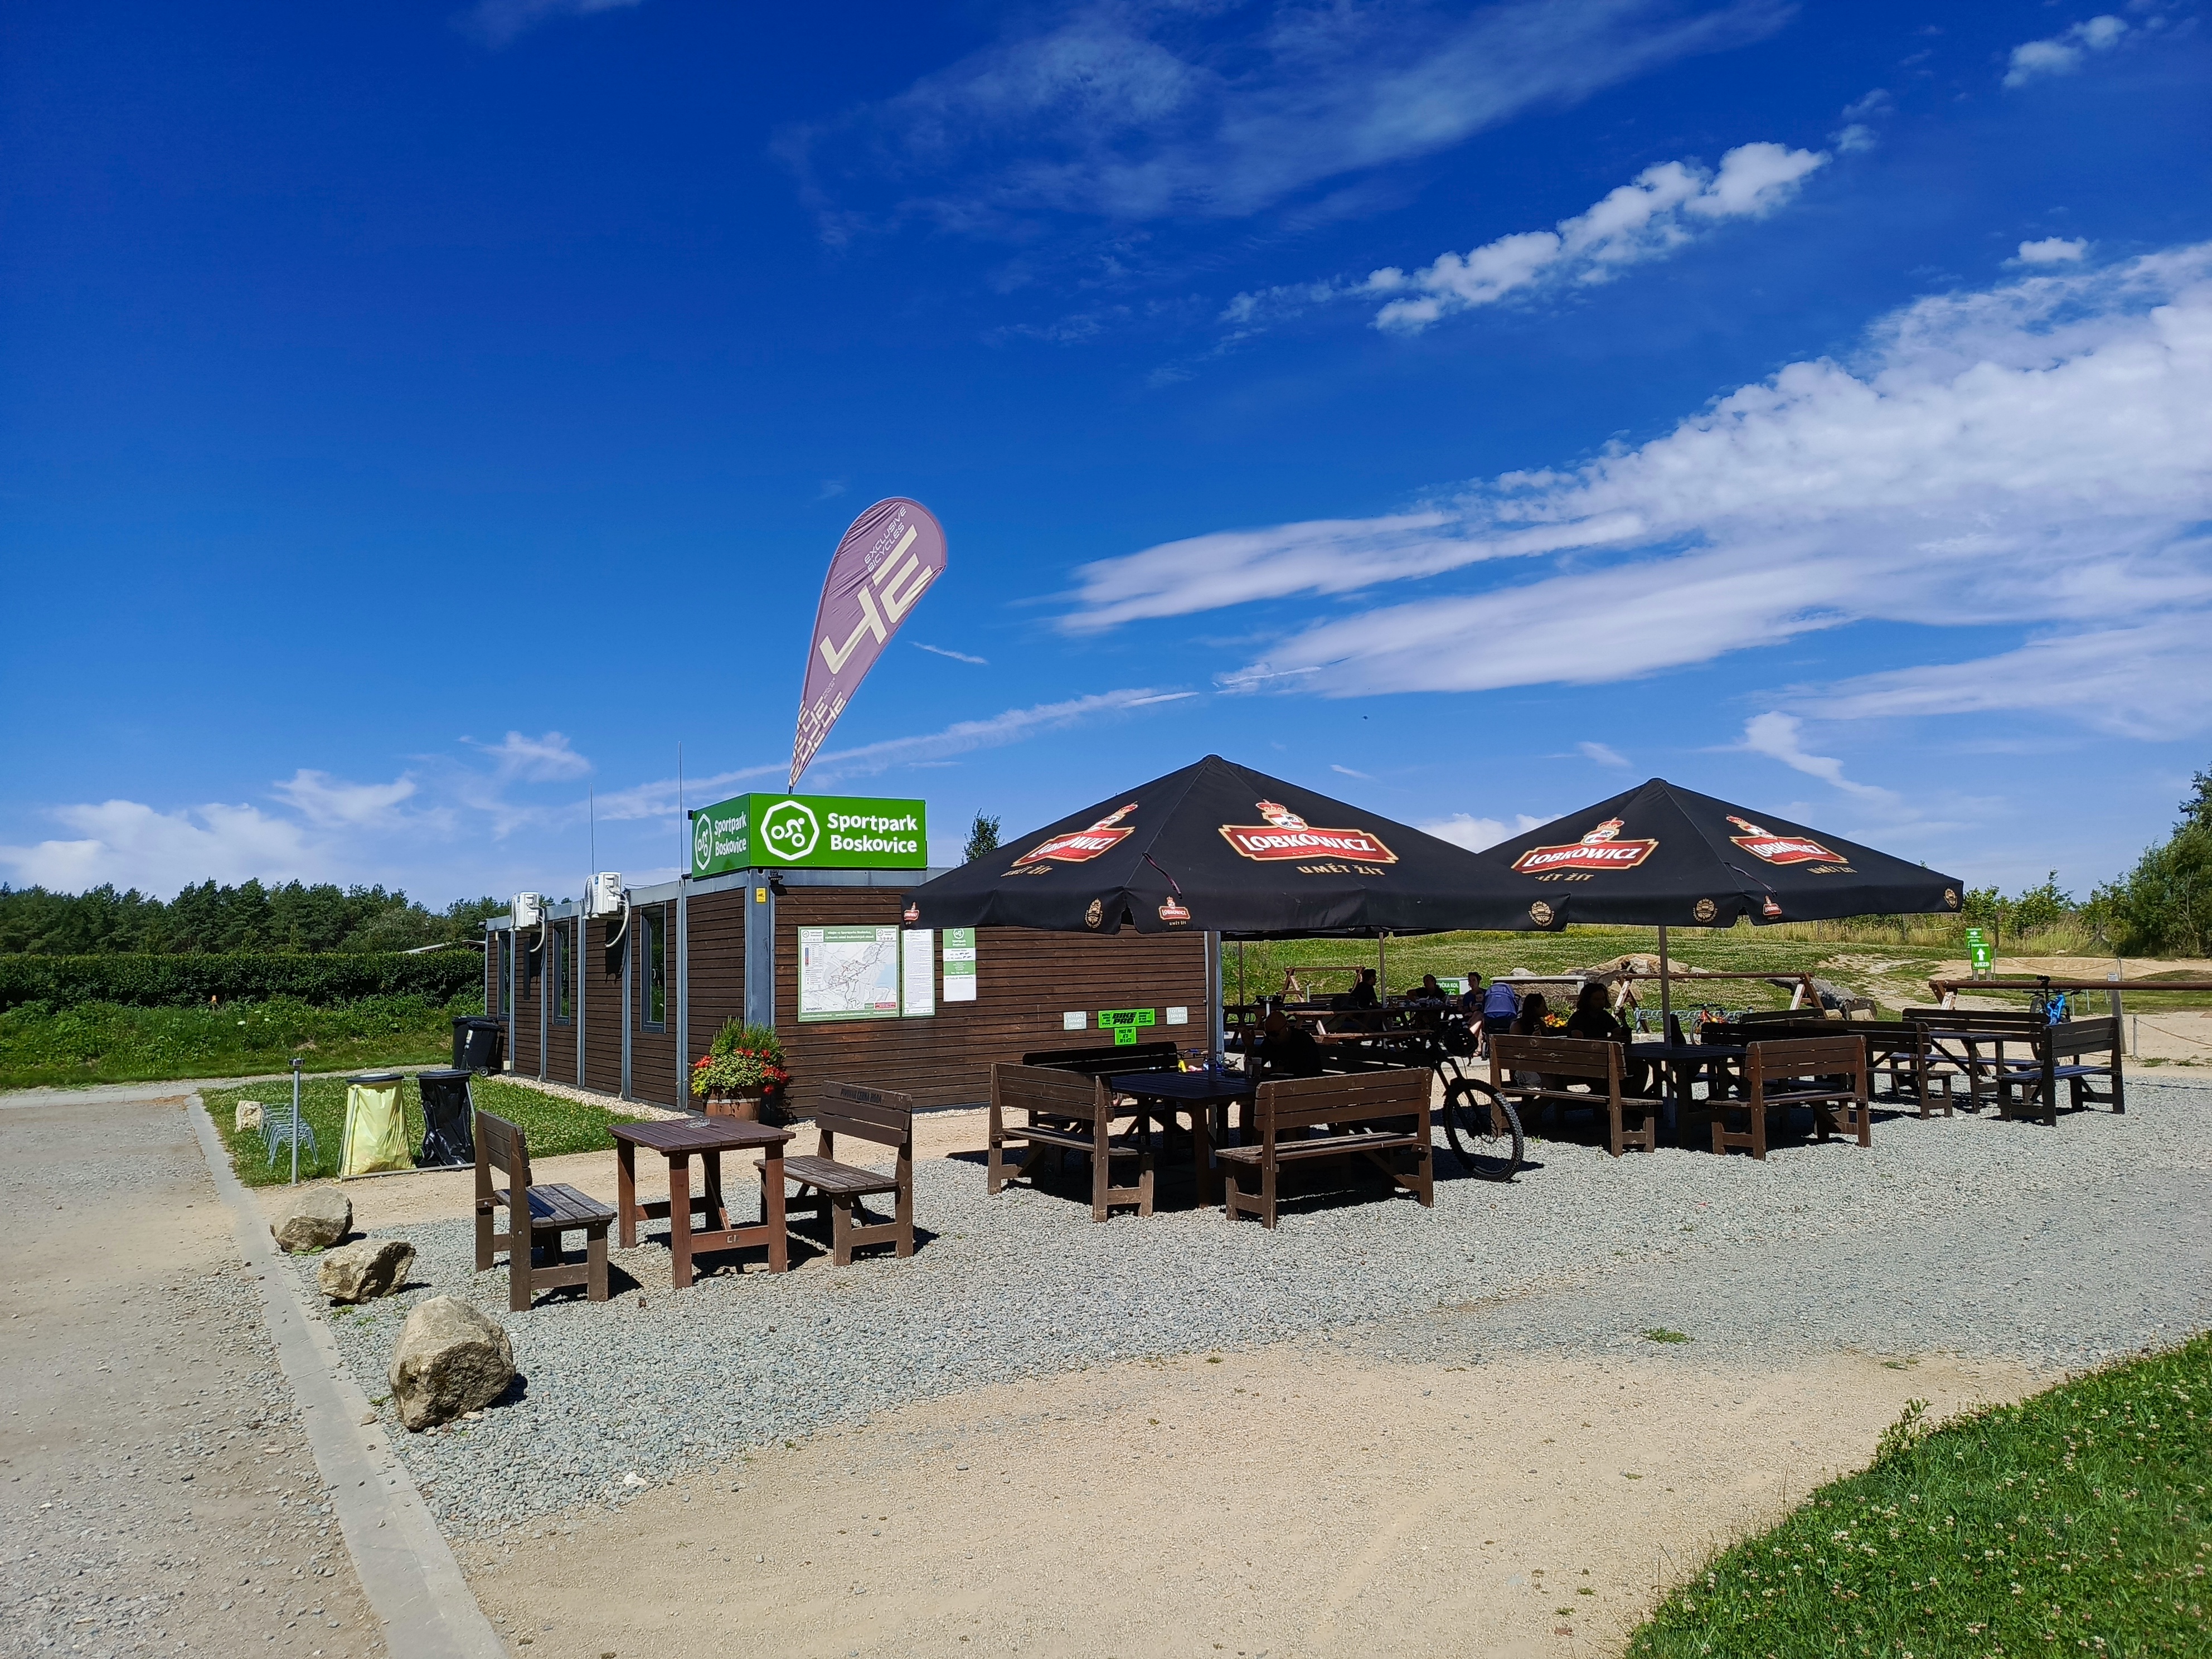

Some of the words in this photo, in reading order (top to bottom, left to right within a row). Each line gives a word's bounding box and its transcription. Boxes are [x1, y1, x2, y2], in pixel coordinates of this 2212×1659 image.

[864, 506, 906, 564] EXCLUSIVE
[867, 522, 904, 572] BICYCLES
[819, 524, 933, 674] 4E
[714, 812, 747, 836] Sportpark
[827, 812, 918, 833] Sportpark
[715, 836, 746, 856] Boskovice
[831, 835, 917, 853] Boskovice
[1236, 833, 1376, 852] LOBKOWICZ
[1521, 847, 1643, 867] LOBKOWICZ
[1296, 862, 1351, 874] UMĚT
[1351, 865, 1385, 876] ŽÍT
